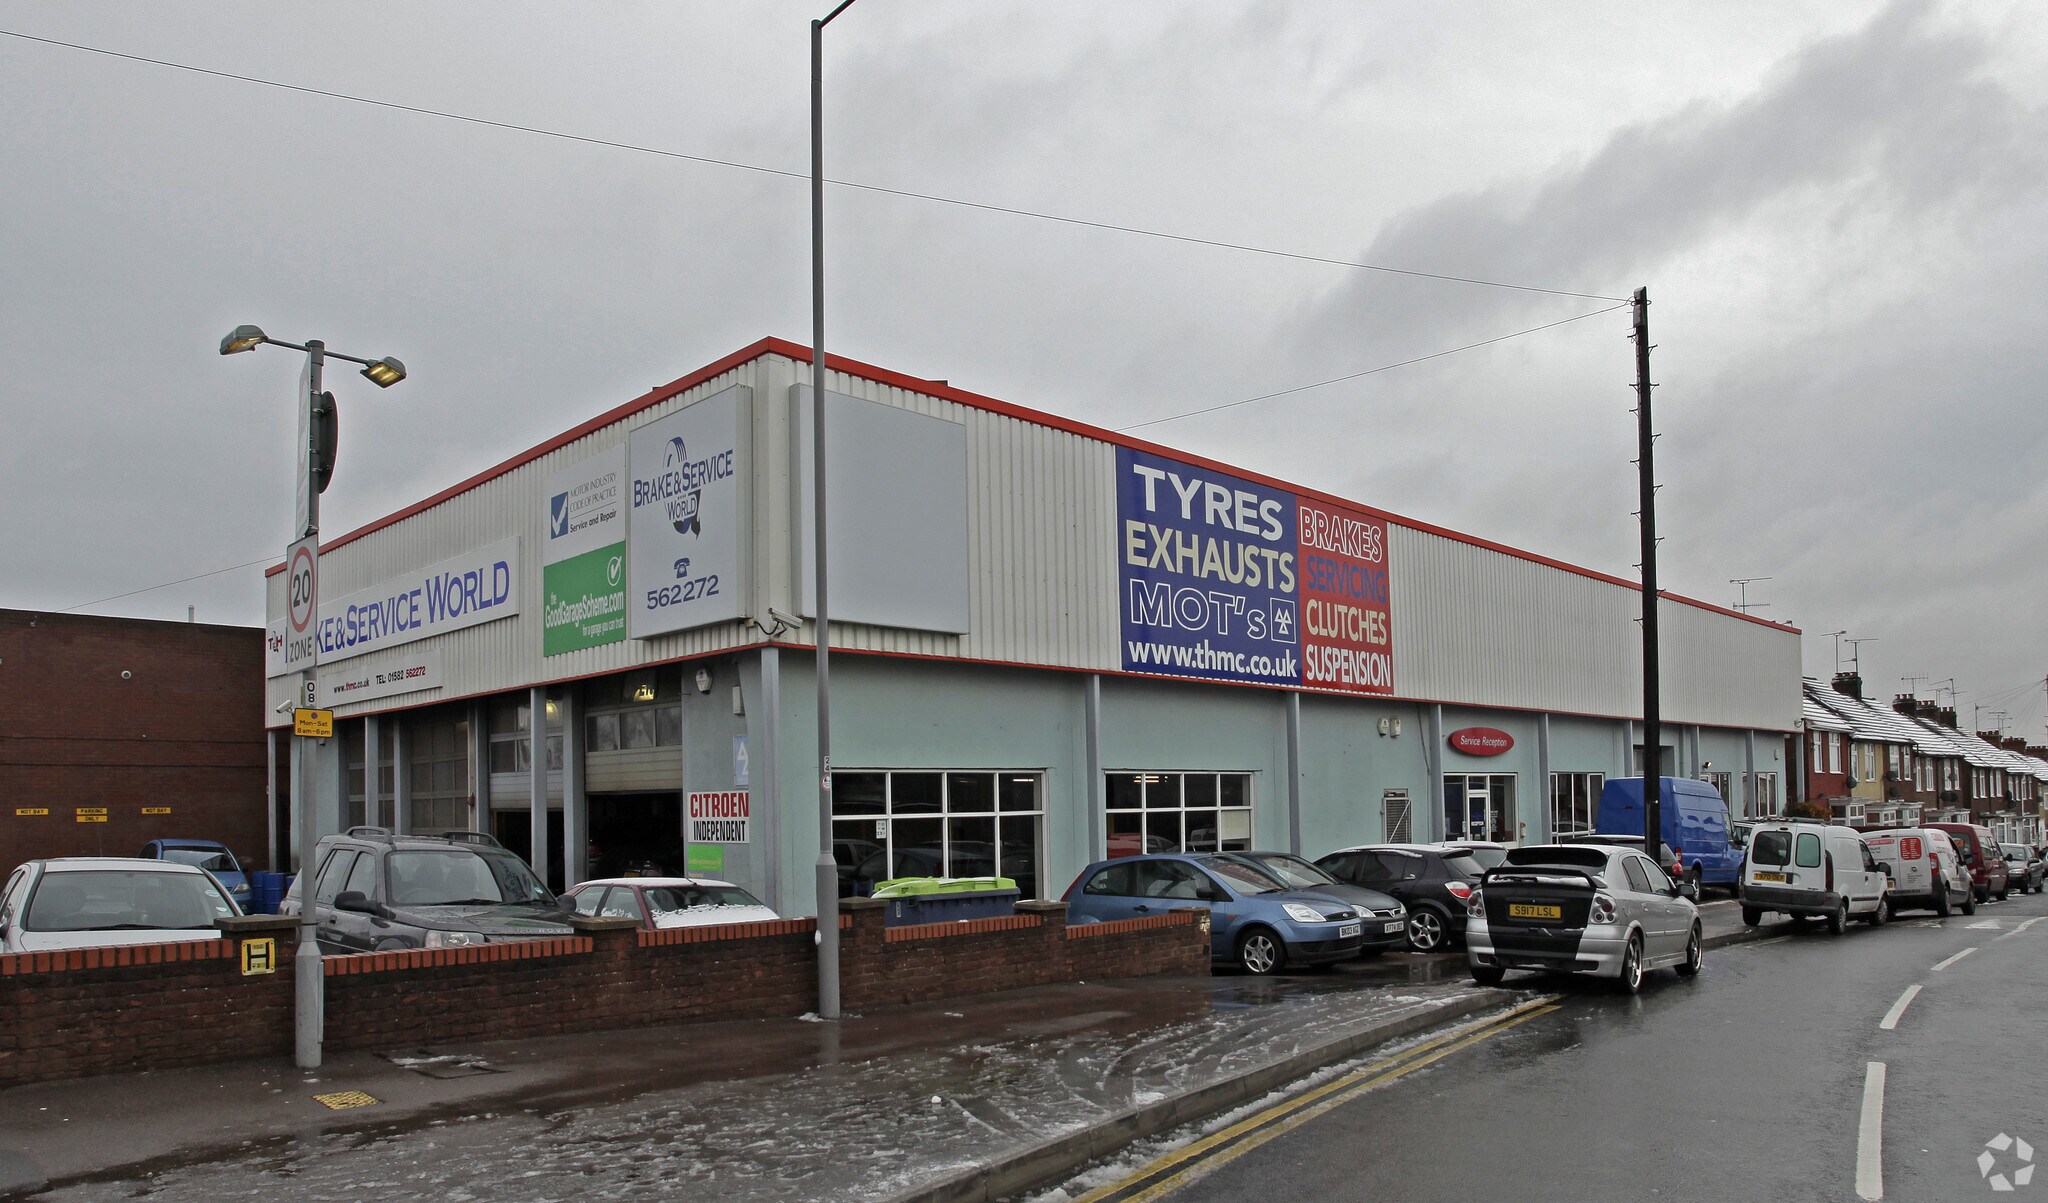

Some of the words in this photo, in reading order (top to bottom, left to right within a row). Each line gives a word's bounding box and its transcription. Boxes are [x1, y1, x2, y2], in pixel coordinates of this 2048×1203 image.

[570, 482, 589, 498] MOTOR
[590, 472, 617, 490] INDUSTRY
[592, 486, 616, 504] PRACTICE
[1133, 464, 1283, 541] TYRES
[570, 521, 587, 533] Service
[588, 513, 599, 526] and
[600, 508, 617, 523] Repair
[667, 497, 697, 520] WORLD
[1300, 505, 1383, 563] BRAKES
[1126, 519, 1295, 593] EXHAUSTS
[293, 569, 311, 608] 20
[425, 560, 510, 625] WORLD
[646, 574, 720, 611] 562272
[1307, 554, 1386, 605] SERVICING
[545, 591, 624, 629] GoodGarageScheme.com
[1129, 578, 1267, 640] MOT's
[1306, 598, 1387, 646] CLUTCHES
[290, 636, 313, 663] ZONE
[1128, 639, 1298, 678] www.thmc.co.uk
[1306, 643, 1391, 688] SUSPENSION
[376, 674, 387, 685] TEL:
[387, 670, 404, 683] 01582
[405, 666, 426, 679] 562272
[1460, 735, 1481, 746] Service
[1482, 736, 1507, 749] Reception
[690, 792, 749, 818] CITROEN
[693, 820, 745, 841] INDEPENDENT
[1515, 905, 1535, 915] S917
[1537, 907, 1554, 917] LSL
